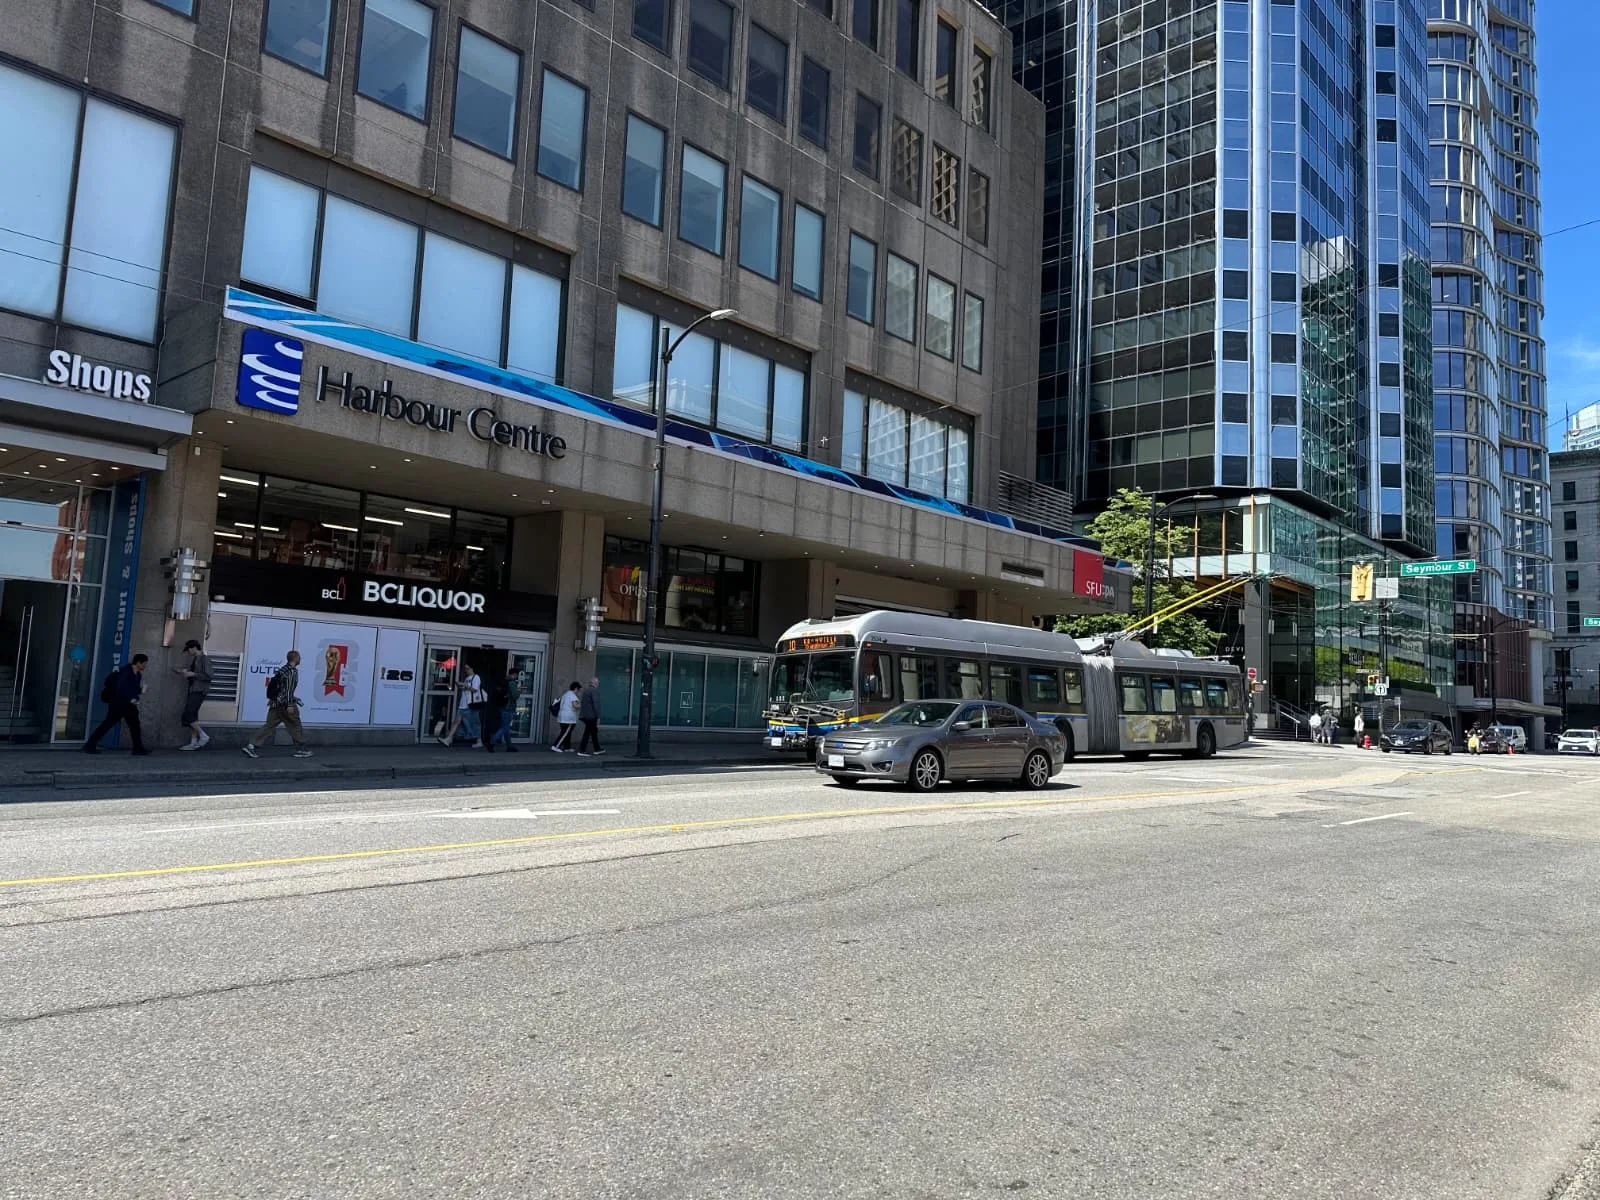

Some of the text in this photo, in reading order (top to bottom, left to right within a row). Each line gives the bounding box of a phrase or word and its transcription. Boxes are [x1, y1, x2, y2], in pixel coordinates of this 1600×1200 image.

[47, 349, 152, 402] Shops
[316, 365, 567, 460] Harbour Centre
[124, 493, 138, 554] Shops
[122, 565, 131, 579] &
[1406, 561, 1470, 574] Seymour St
[322, 588, 343, 601] BCL
[1085, 580, 1102, 597] SFU
[363, 580, 485, 613] BCLIQUOR
[114, 591, 128, 646] Court
[788, 639, 796, 651] 10
[250, 665, 281, 675] ULTR
[386, 669, 414, 681] 26
